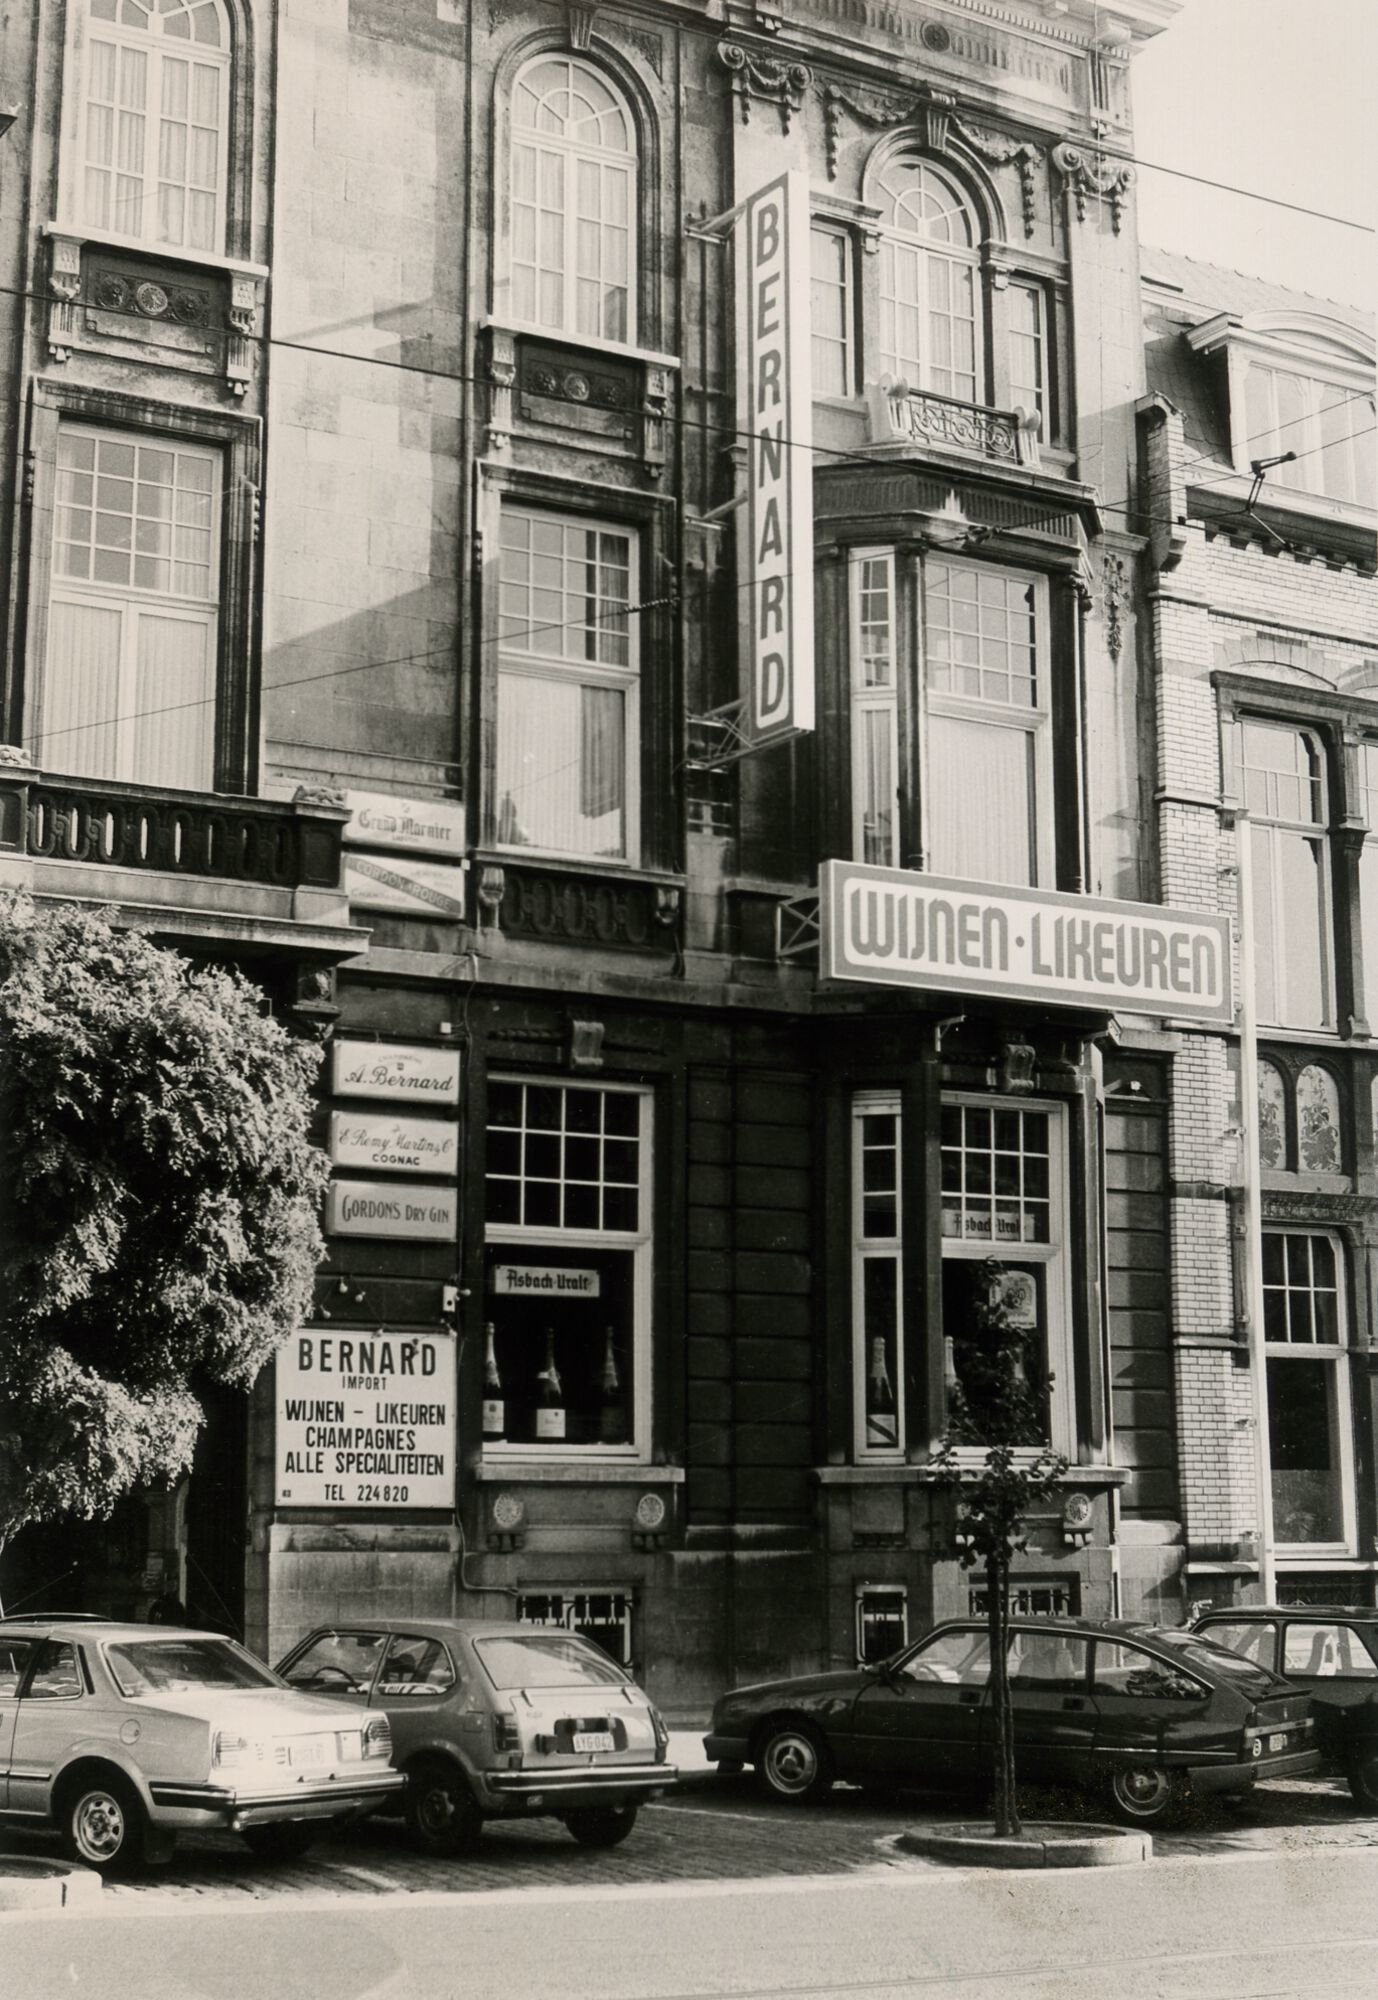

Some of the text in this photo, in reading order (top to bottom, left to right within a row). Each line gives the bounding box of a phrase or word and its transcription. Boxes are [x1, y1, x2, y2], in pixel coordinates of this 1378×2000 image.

[754, 202, 785, 719] BERNARD
[399, 816, 453, 841] Marnier
[356, 861, 405, 890] CORDON
[412, 882, 449, 911] ROUGE
[851, 888, 1009, 972] WIJNEN
[1031, 912, 1216, 997] LIKEUREN
[369, 1065, 454, 1091] Bernard
[371, 1153, 421, 1166] COGNAC
[405, 1204, 427, 1222] DRY
[429, 1206, 449, 1223] GIN
[506, 1268, 592, 1291] Asbach Uralt
[298, 1338, 436, 1376] BERNARD
[342, 1376, 387, 1390] IMPORT
[285, 1400, 344, 1423] WIJNEN
[376, 1402, 446, 1426] LIKEUREN
[306, 1426, 416, 1451] CHAMPAGNES
[285, 1452, 444, 1475] ALLE SPECIALITEITEN
[325, 1484, 345, 1501] TEL
